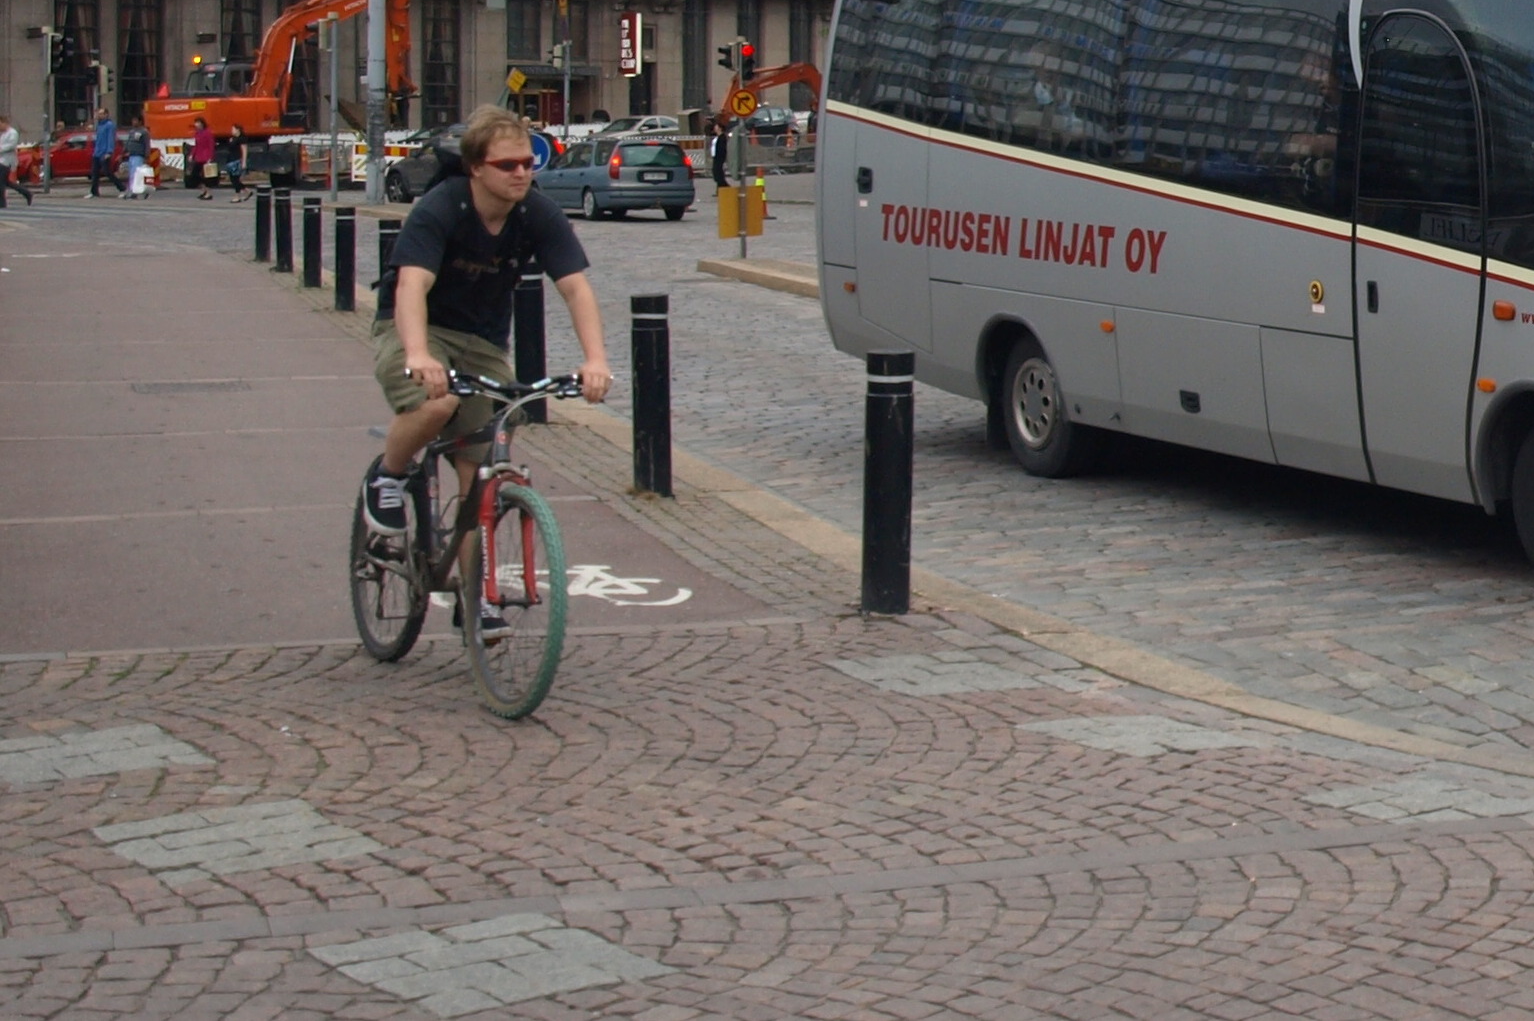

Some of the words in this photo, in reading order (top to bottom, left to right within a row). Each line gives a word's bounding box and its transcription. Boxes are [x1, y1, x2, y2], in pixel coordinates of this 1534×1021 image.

[881, 203, 1010, 256] TOURUSEN
[1018, 218, 1116, 268] LINJAT
[1125, 227, 1168, 274] OY
